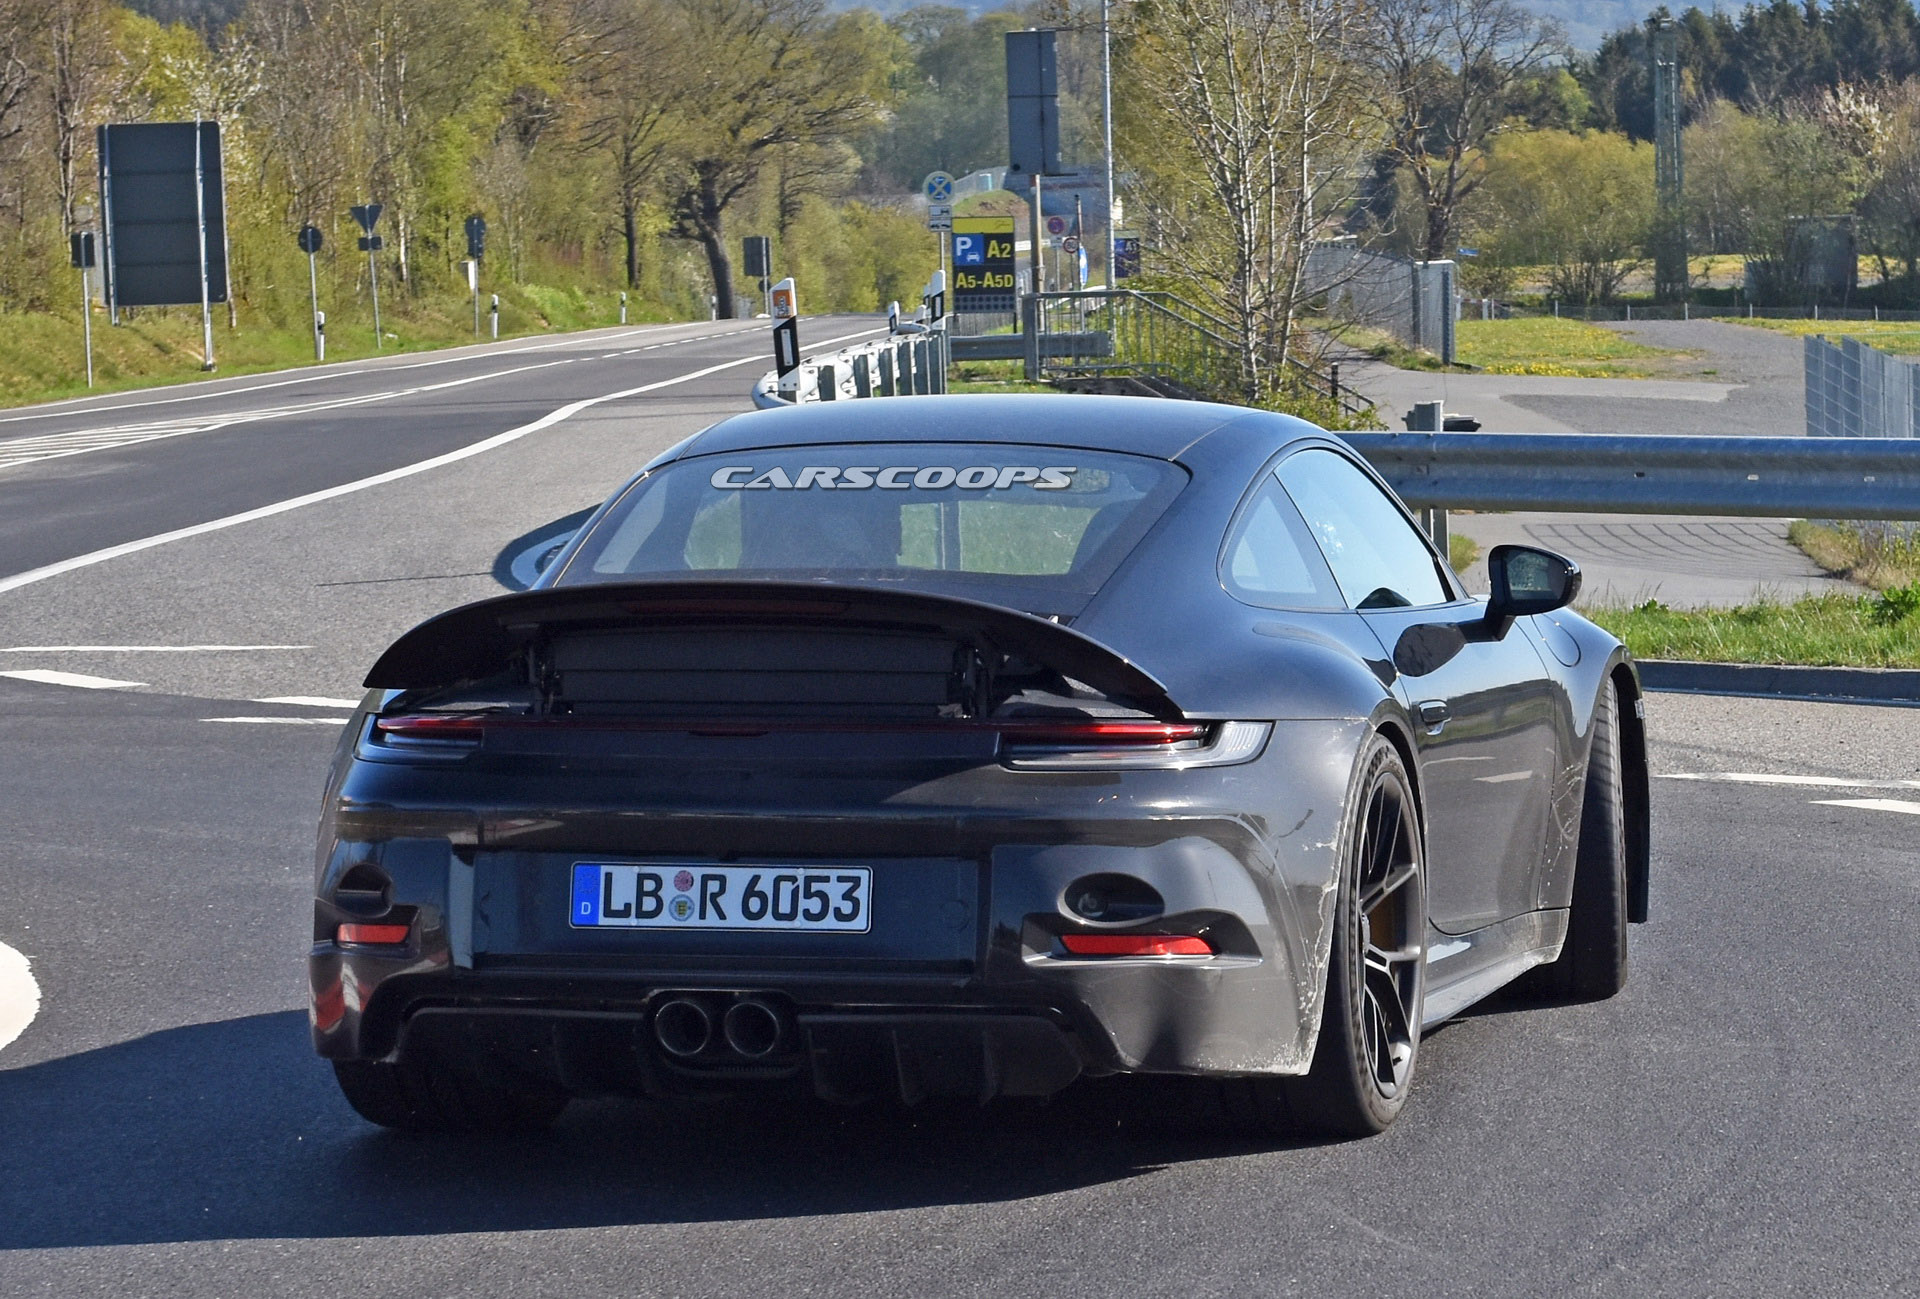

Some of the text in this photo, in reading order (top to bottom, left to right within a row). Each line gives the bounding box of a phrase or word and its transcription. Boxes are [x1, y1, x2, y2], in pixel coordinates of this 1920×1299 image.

[956, 236, 1011, 258] P A2
[956, 272, 1013, 288] A5-A5D
[603, 872, 861, 922] LB R 6053
[580, 901, 591, 915] D
